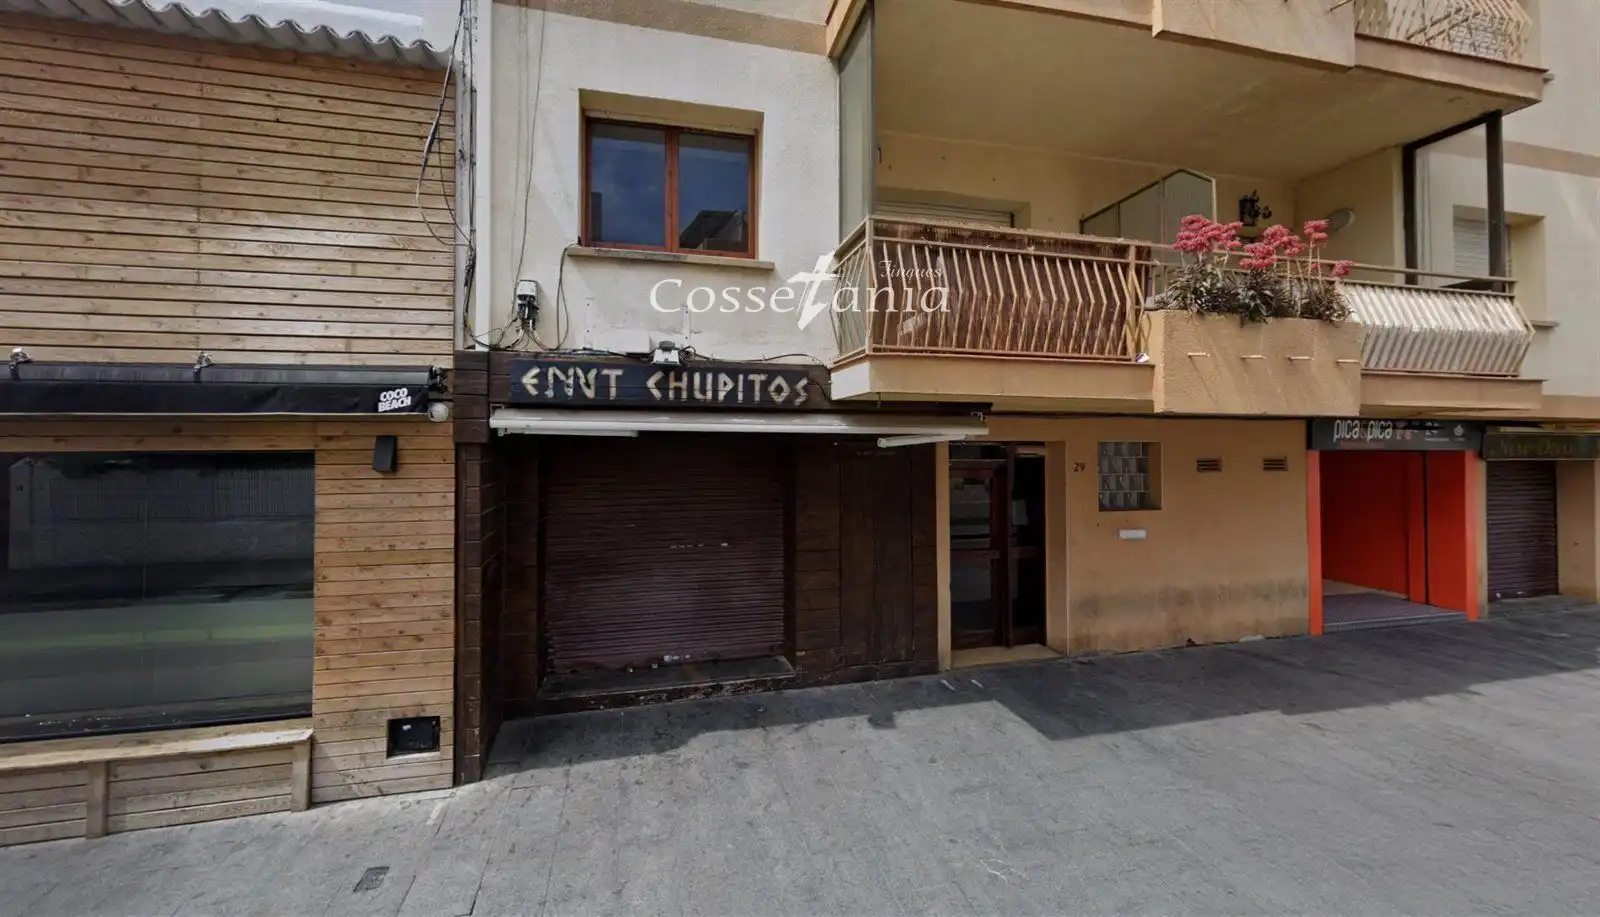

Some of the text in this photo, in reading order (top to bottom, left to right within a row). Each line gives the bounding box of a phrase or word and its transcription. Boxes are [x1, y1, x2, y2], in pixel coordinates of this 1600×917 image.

[379, 387, 408, 402] COCO
[646, 370, 809, 406] CHUPITOS
[377, 396, 412, 413] BEACH
[1070, 462, 1086, 474] 29
